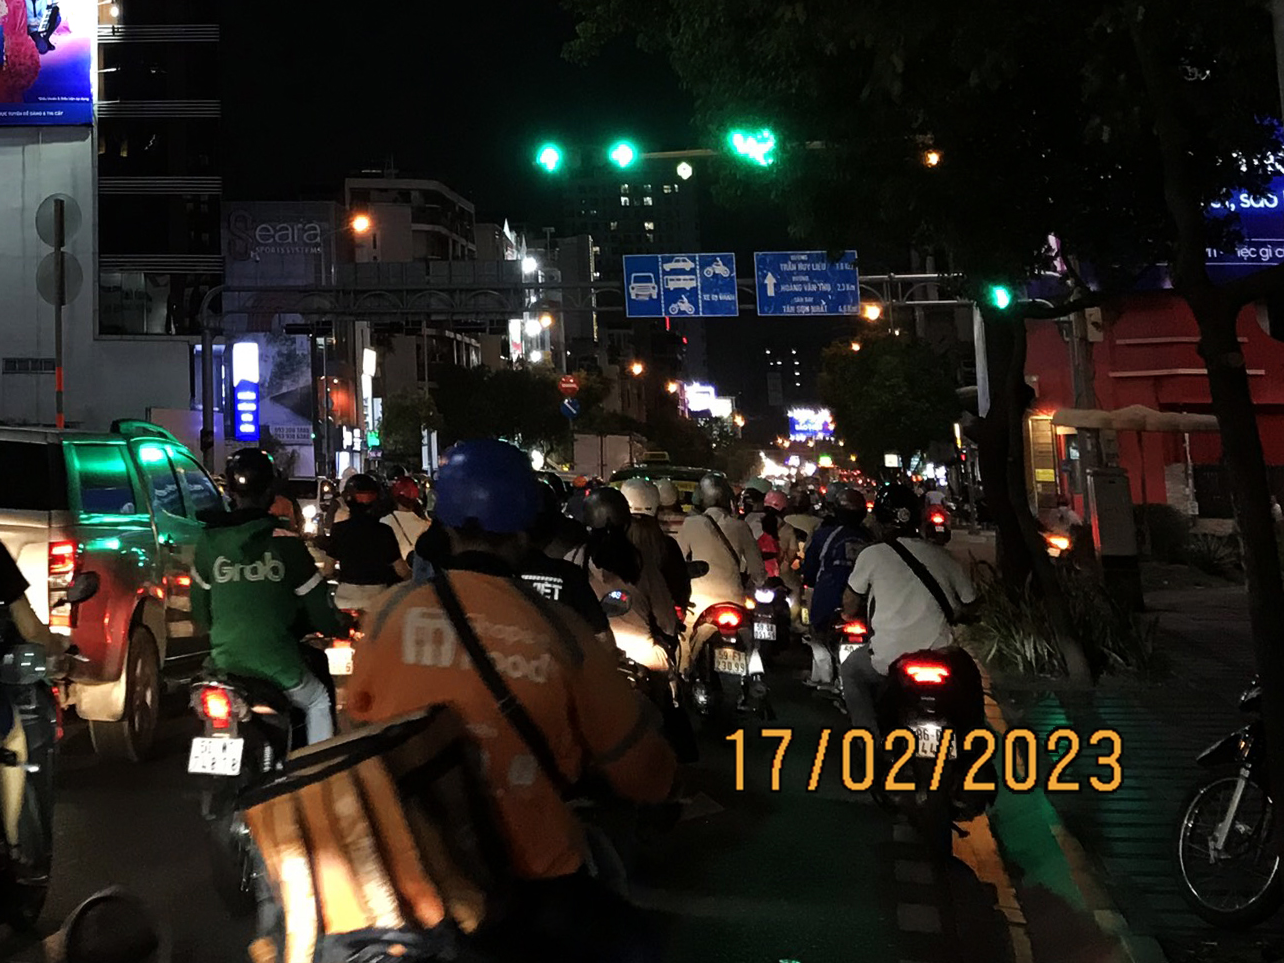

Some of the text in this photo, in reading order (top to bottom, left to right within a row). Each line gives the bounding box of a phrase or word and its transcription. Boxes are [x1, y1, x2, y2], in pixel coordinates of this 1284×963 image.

[228, 209, 321, 261] Seara
[1259, 244, 1273, 262] gì
[213, 552, 285, 583] Grab
